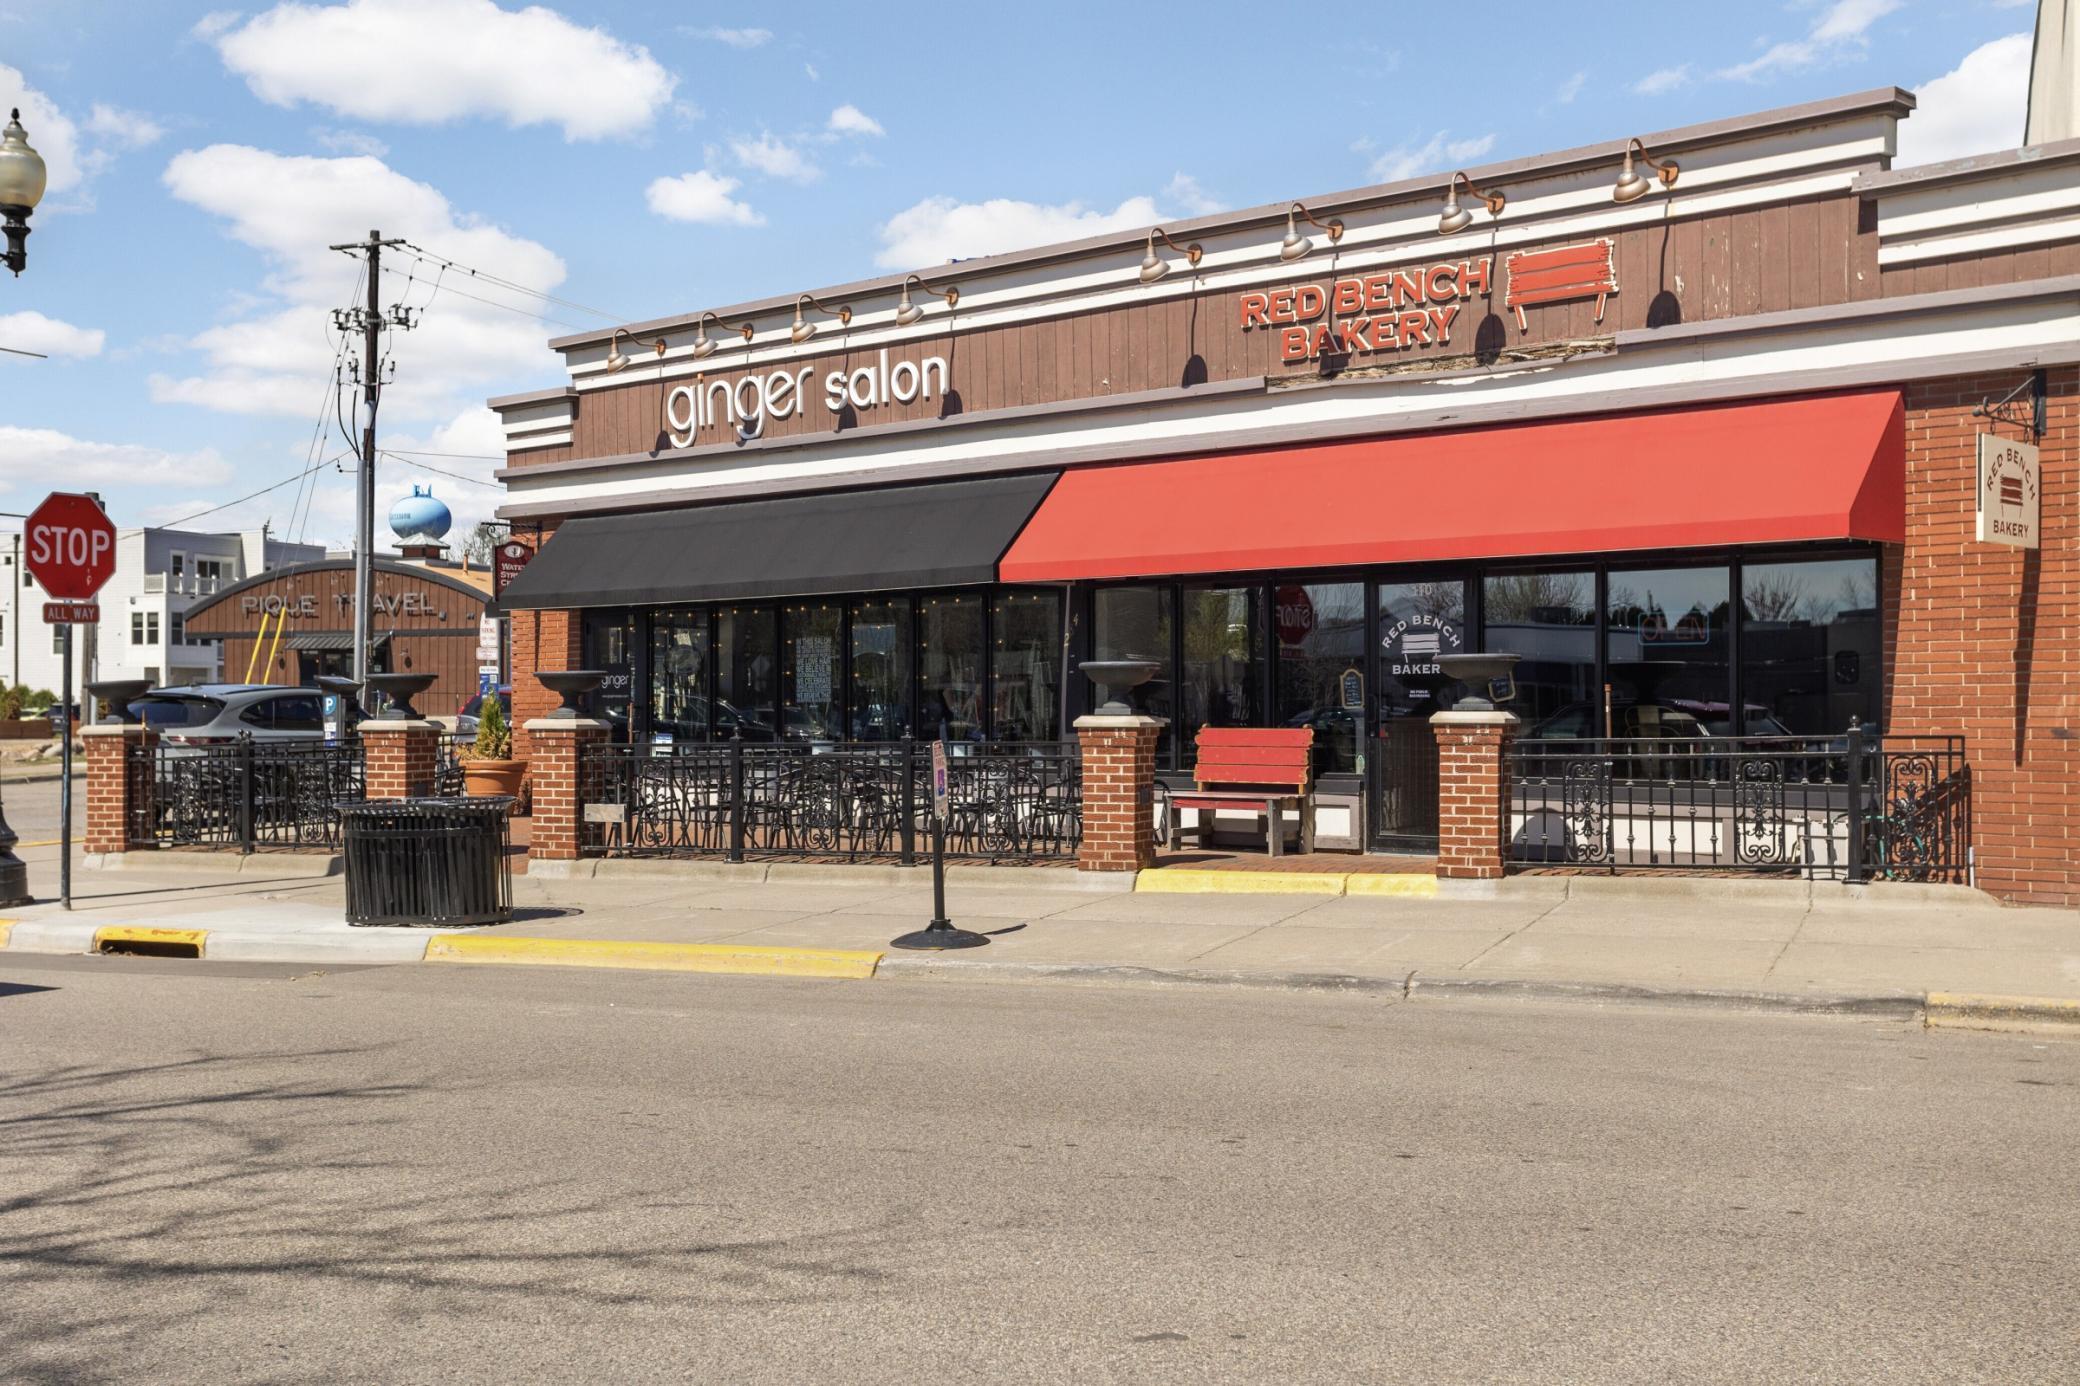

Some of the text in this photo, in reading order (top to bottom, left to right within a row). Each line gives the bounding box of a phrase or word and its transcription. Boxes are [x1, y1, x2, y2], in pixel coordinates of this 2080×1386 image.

[1240, 258, 1492, 329] RED BENCH
[1281, 305, 1460, 362] BAKERY
[667, 348, 949, 449] ginger salon
[1986, 448, 2036, 500] RED BENCH
[1993, 519, 2029, 538] BAKERY
[32, 524, 110, 567] STOP
[48, 607, 95, 620] ALL WAY
[241, 594, 316, 614] PIQUE
[1382, 614, 1461, 649] RED BENCH
[601, 674, 629, 688] ginger
[1392, 664, 1441, 675] BAKER
[325, 697, 334, 711] P
